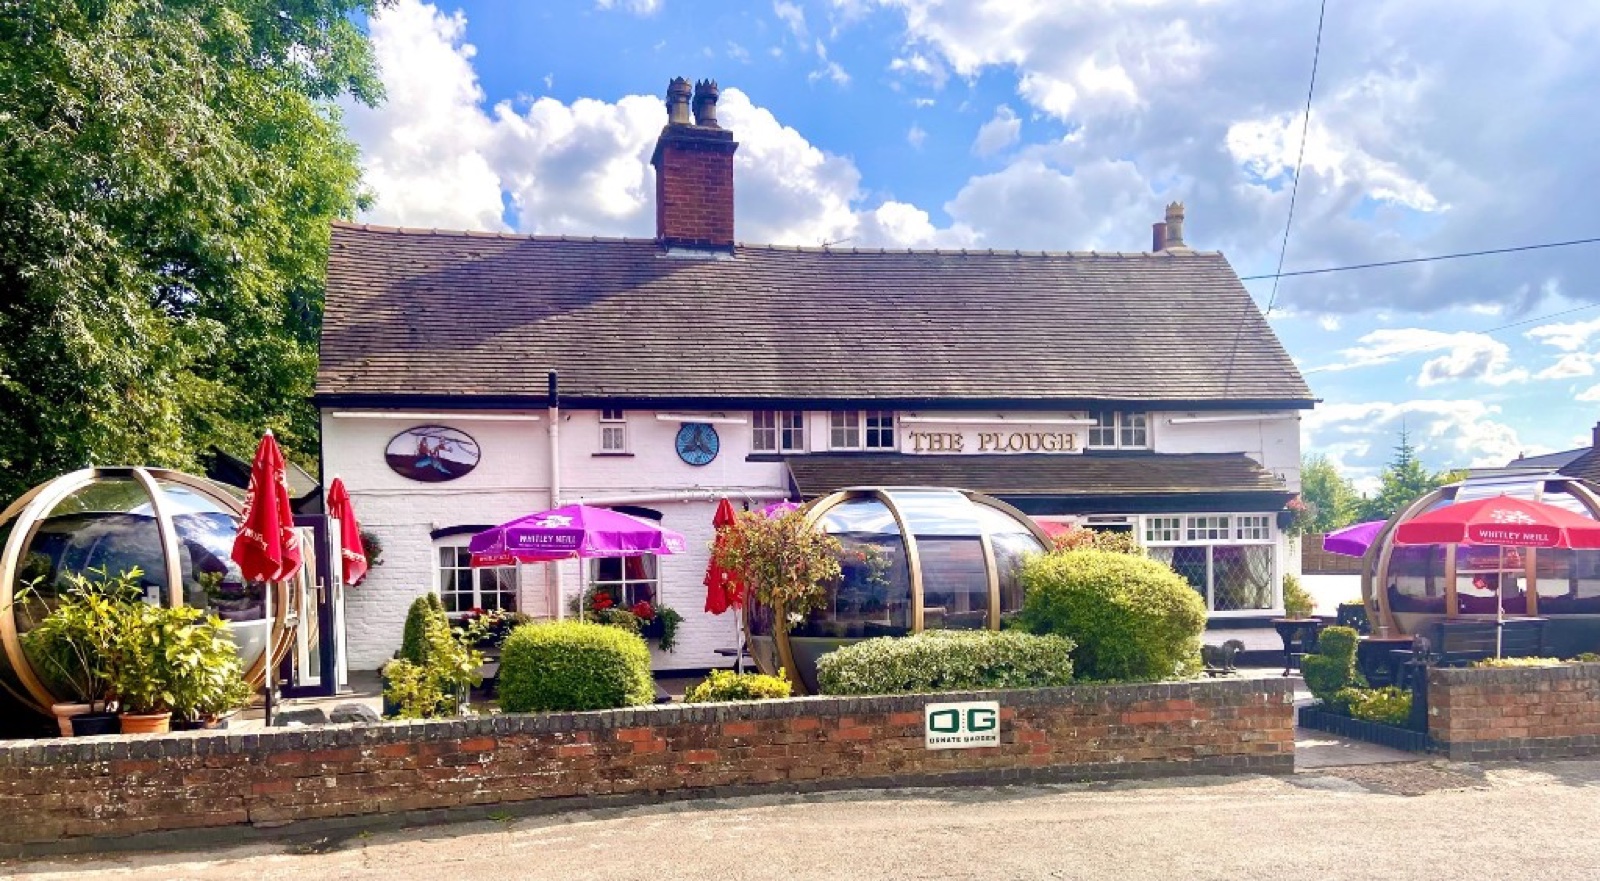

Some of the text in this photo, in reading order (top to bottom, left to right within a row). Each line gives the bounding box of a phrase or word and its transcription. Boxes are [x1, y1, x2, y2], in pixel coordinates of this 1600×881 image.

[909, 431, 1078, 452] THE PLOUGH
[1479, 530, 1549, 541] WHITLEY NEILL
